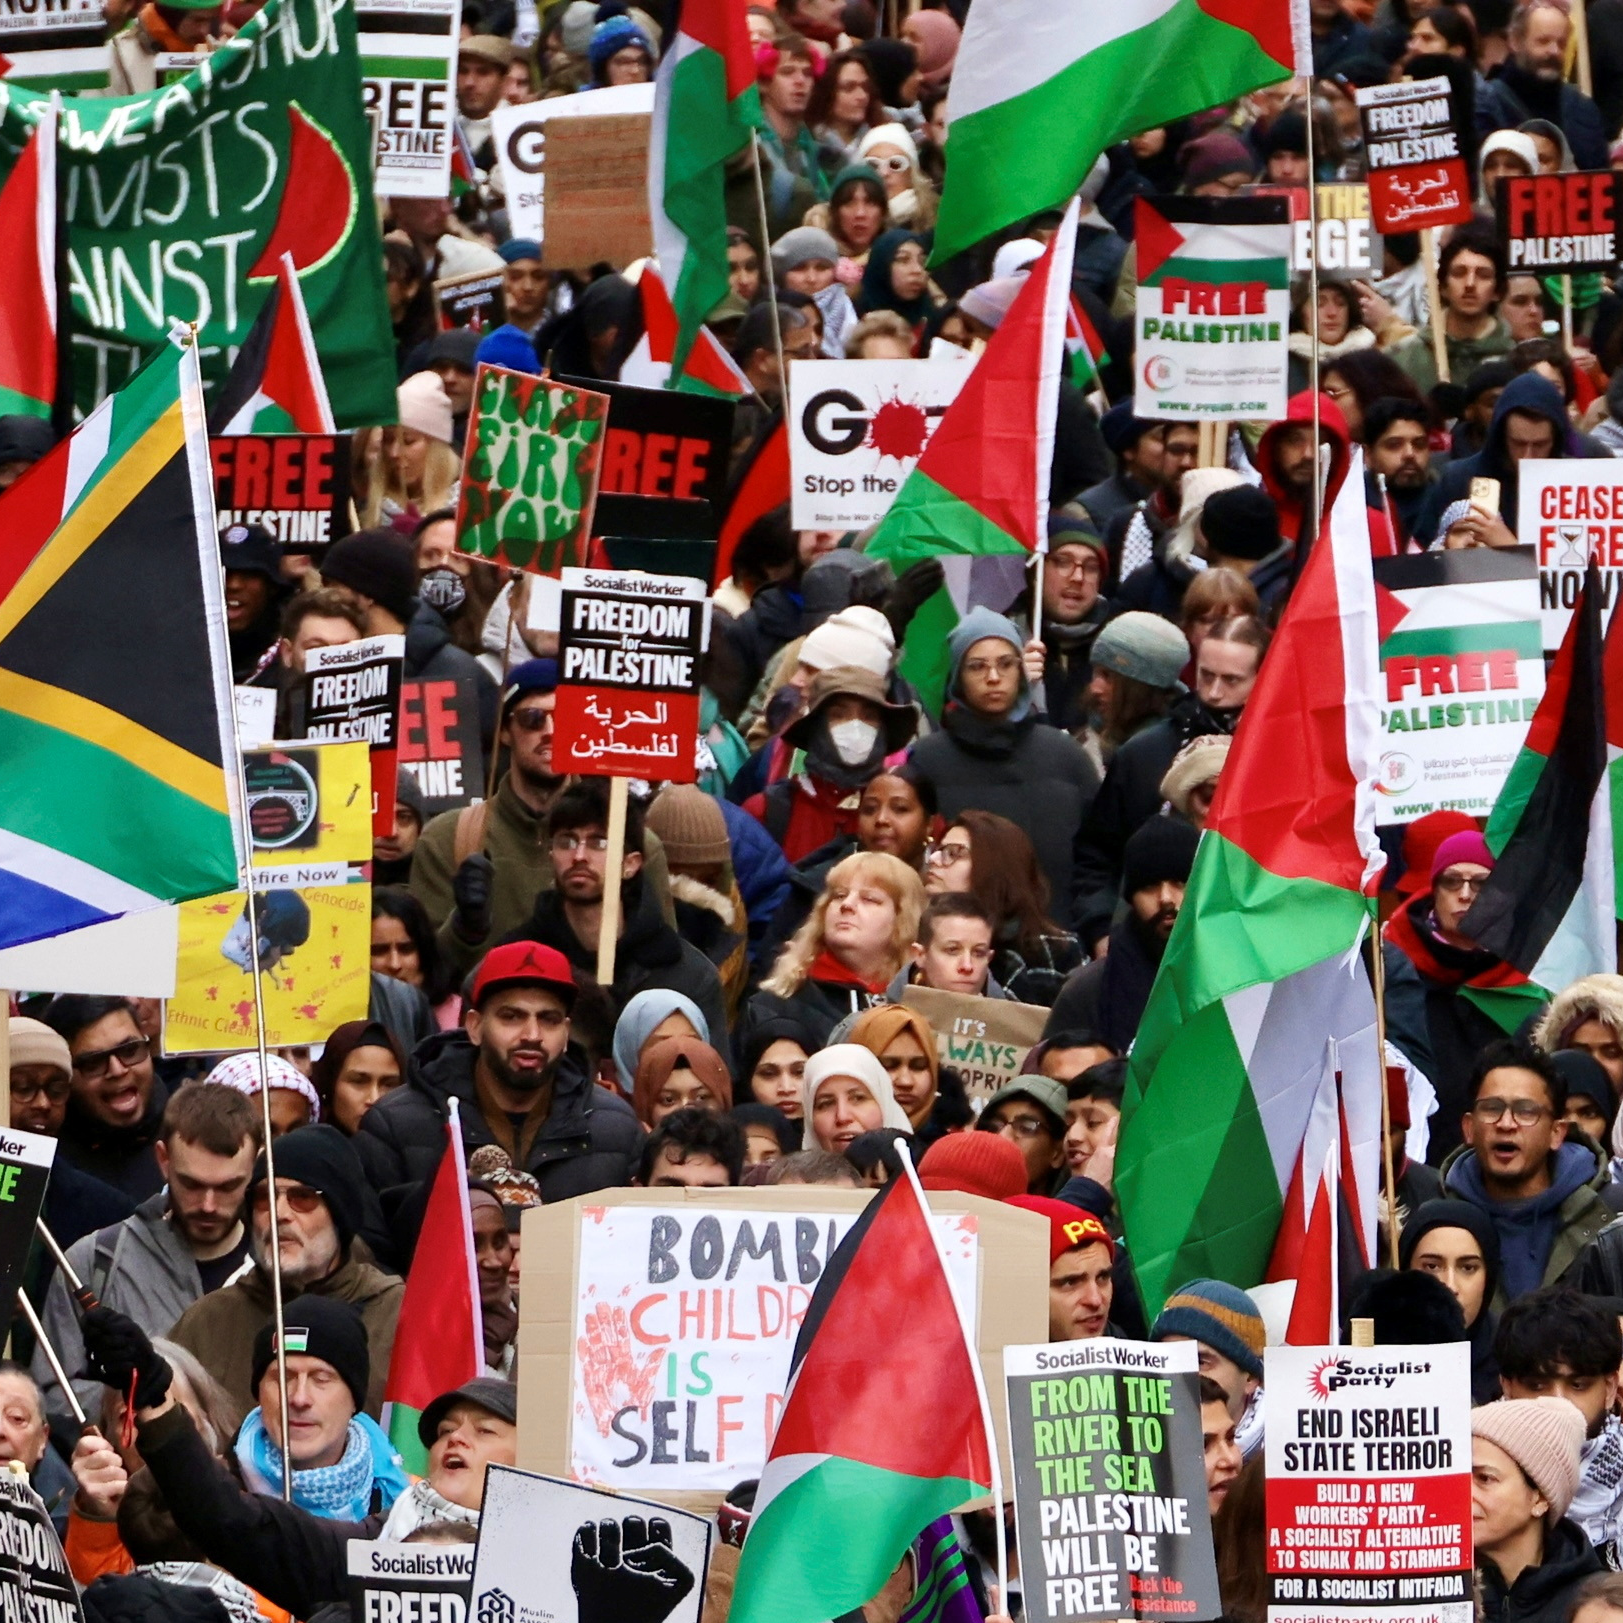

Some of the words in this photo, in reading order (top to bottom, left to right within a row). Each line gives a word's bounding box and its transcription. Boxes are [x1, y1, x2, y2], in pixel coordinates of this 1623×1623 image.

[1368, 99, 1450, 133] FREEDOM
[1369, 133, 1459, 168] PALESTINE
[1508, 173, 1615, 237] FREE
[1509, 234, 1615, 266] PALESTINE
[1160, 276, 1269, 315] FREE
[1143, 318, 1281, 343] PALESTINE
[574, 597, 690, 638] FREEDOM
[621, 635, 641, 651] for
[564, 647, 693, 687] PALESTINE
[1386, 650, 1518, 702] FREE
[584, 695, 668, 726] الحرية
[572, 734, 678, 758] لفلسطين
[297, 870, 337, 882] Now
[303, 887, 365, 912] Genocide
[669, 1352, 713, 1394] IS
[1336, 1360, 1431, 1375] Socialist
[1298, 1409, 1343, 1438] END
[1351, 1407, 1439, 1437] ISRAELI
[1284, 1442, 1355, 1471] STATE
[1364, 1439, 1452, 1471] TERROR
[1317, 1484, 1360, 1502] BUILD
[1366, 1485, 1376, 1502] A
[1381, 1483, 1414, 1502] NEW
[1378, 1506, 1425, 1525] PARTY
[1270, 1530, 1280, 1546] A
[1286, 1528, 1361, 1547] SOCIALIST
[1366, 1525, 1461, 1548] ALTERNATIVE
[1276, 1550, 1295, 1568] TO
[1300, 1550, 1350, 1569] SUNAK
[1354, 1551, 1385, 1569] AND
[1390, 1547, 1460, 1570] STARMER
[1275, 1579, 1303, 1598] FOR
[1307, 1579, 1317, 1598] A
[1322, 1579, 1395, 1599] SOCIALIST
[1399, 1576, 1463, 1598] INTIFADA
